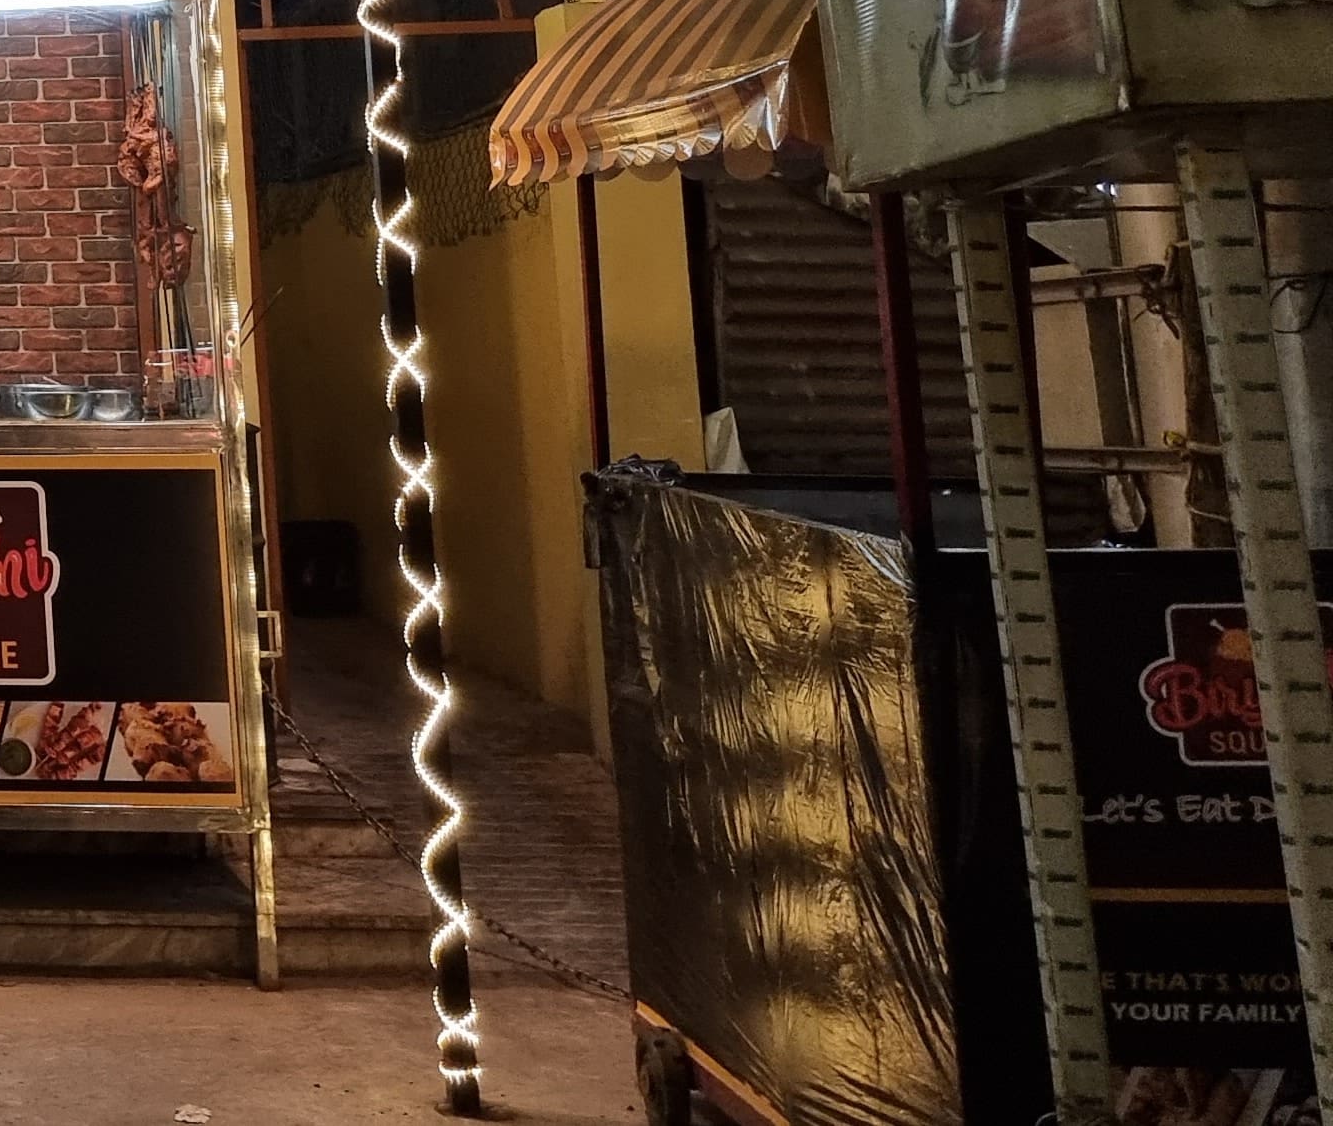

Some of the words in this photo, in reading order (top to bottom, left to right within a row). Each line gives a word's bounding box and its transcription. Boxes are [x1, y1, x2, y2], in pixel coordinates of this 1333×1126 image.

[1209, 730, 1266, 755] SQU
[1176, 793, 1242, 823] Eat
[1124, 971, 1229, 993] THAT'S
[1110, 1001, 1190, 1023] YOUR
[1197, 1000, 1302, 1023] FAMILY
